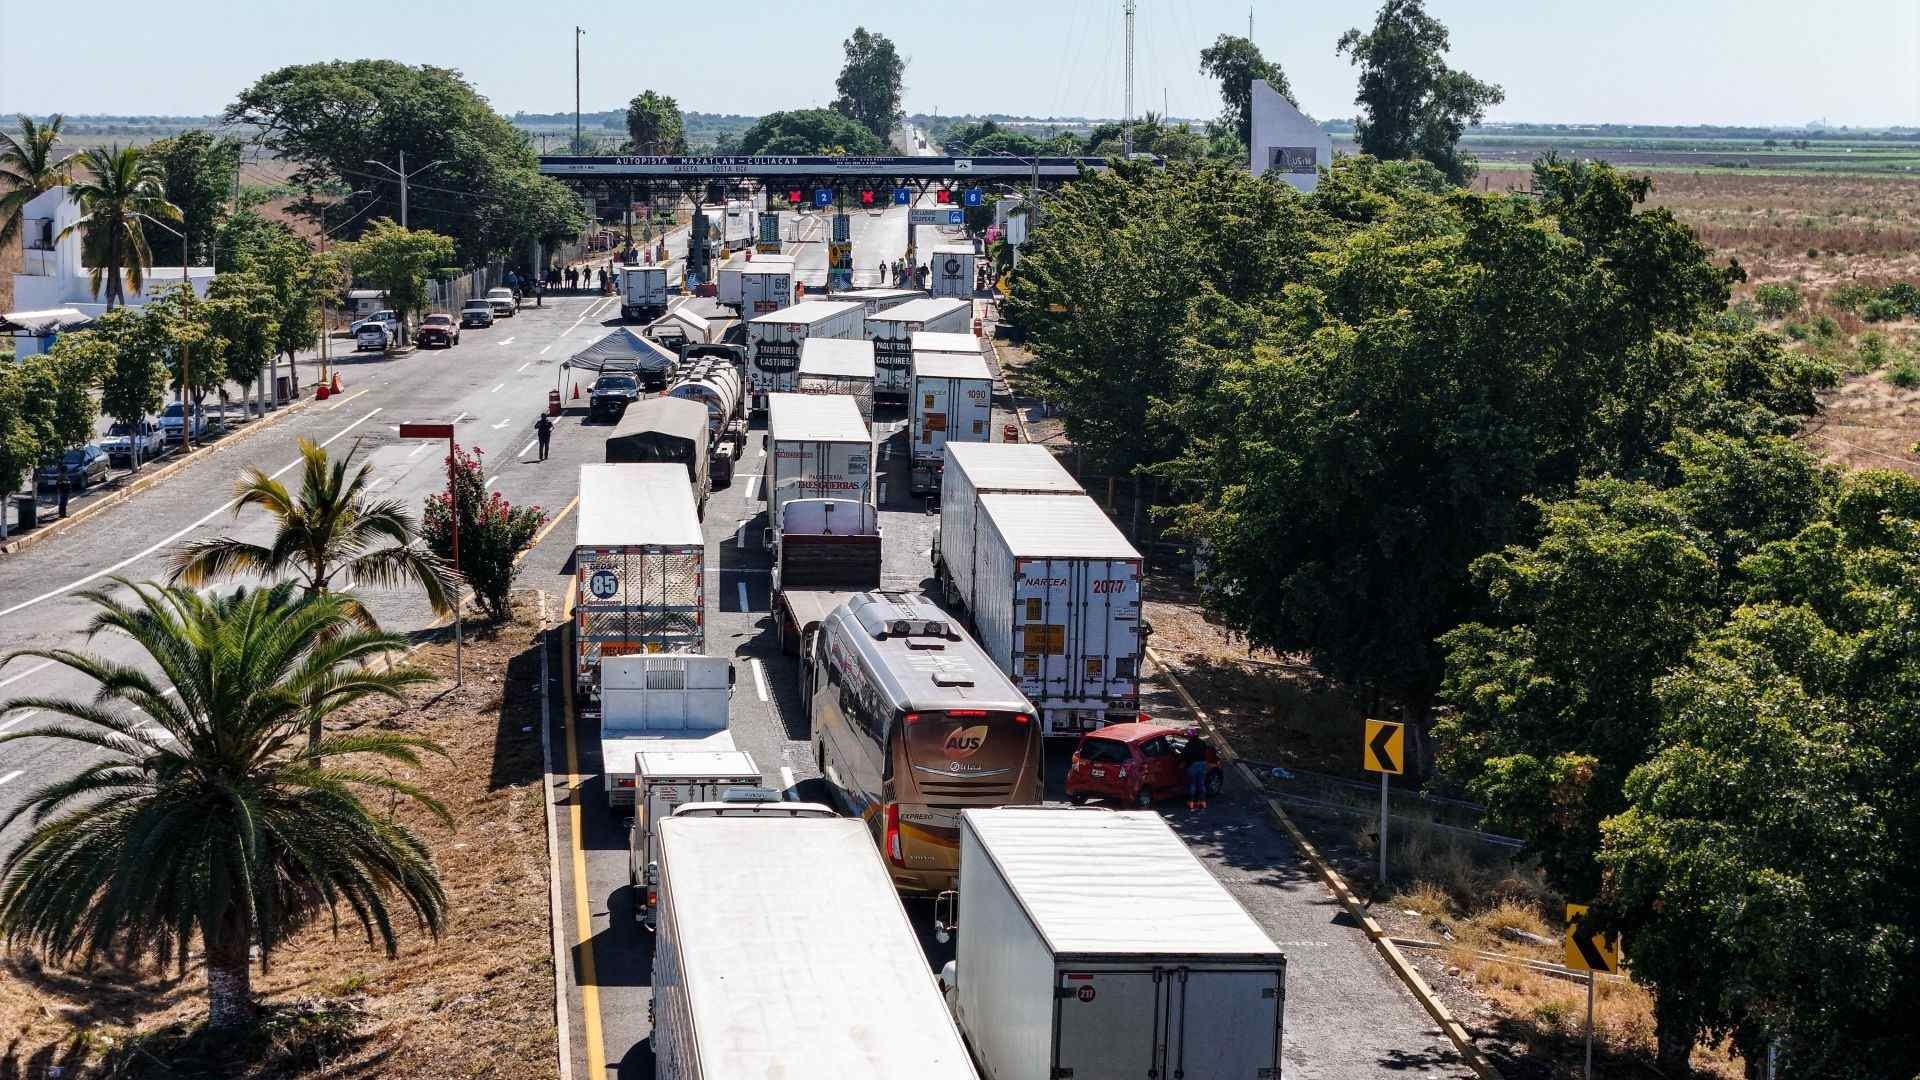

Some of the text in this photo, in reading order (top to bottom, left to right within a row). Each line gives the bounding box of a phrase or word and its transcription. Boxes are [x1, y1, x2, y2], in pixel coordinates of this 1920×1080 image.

[616, 157, 668, 165] AUTOPISTA
[681, 157, 735, 165] MAZATLAN
[747, 157, 798, 165] CULIACAN
[821, 193, 827, 202] 2
[970, 193, 976, 202] 6
[593, 575, 616, 594] 85
[1093, 580, 1126, 594] 2077
[945, 737, 981, 750] AUS
